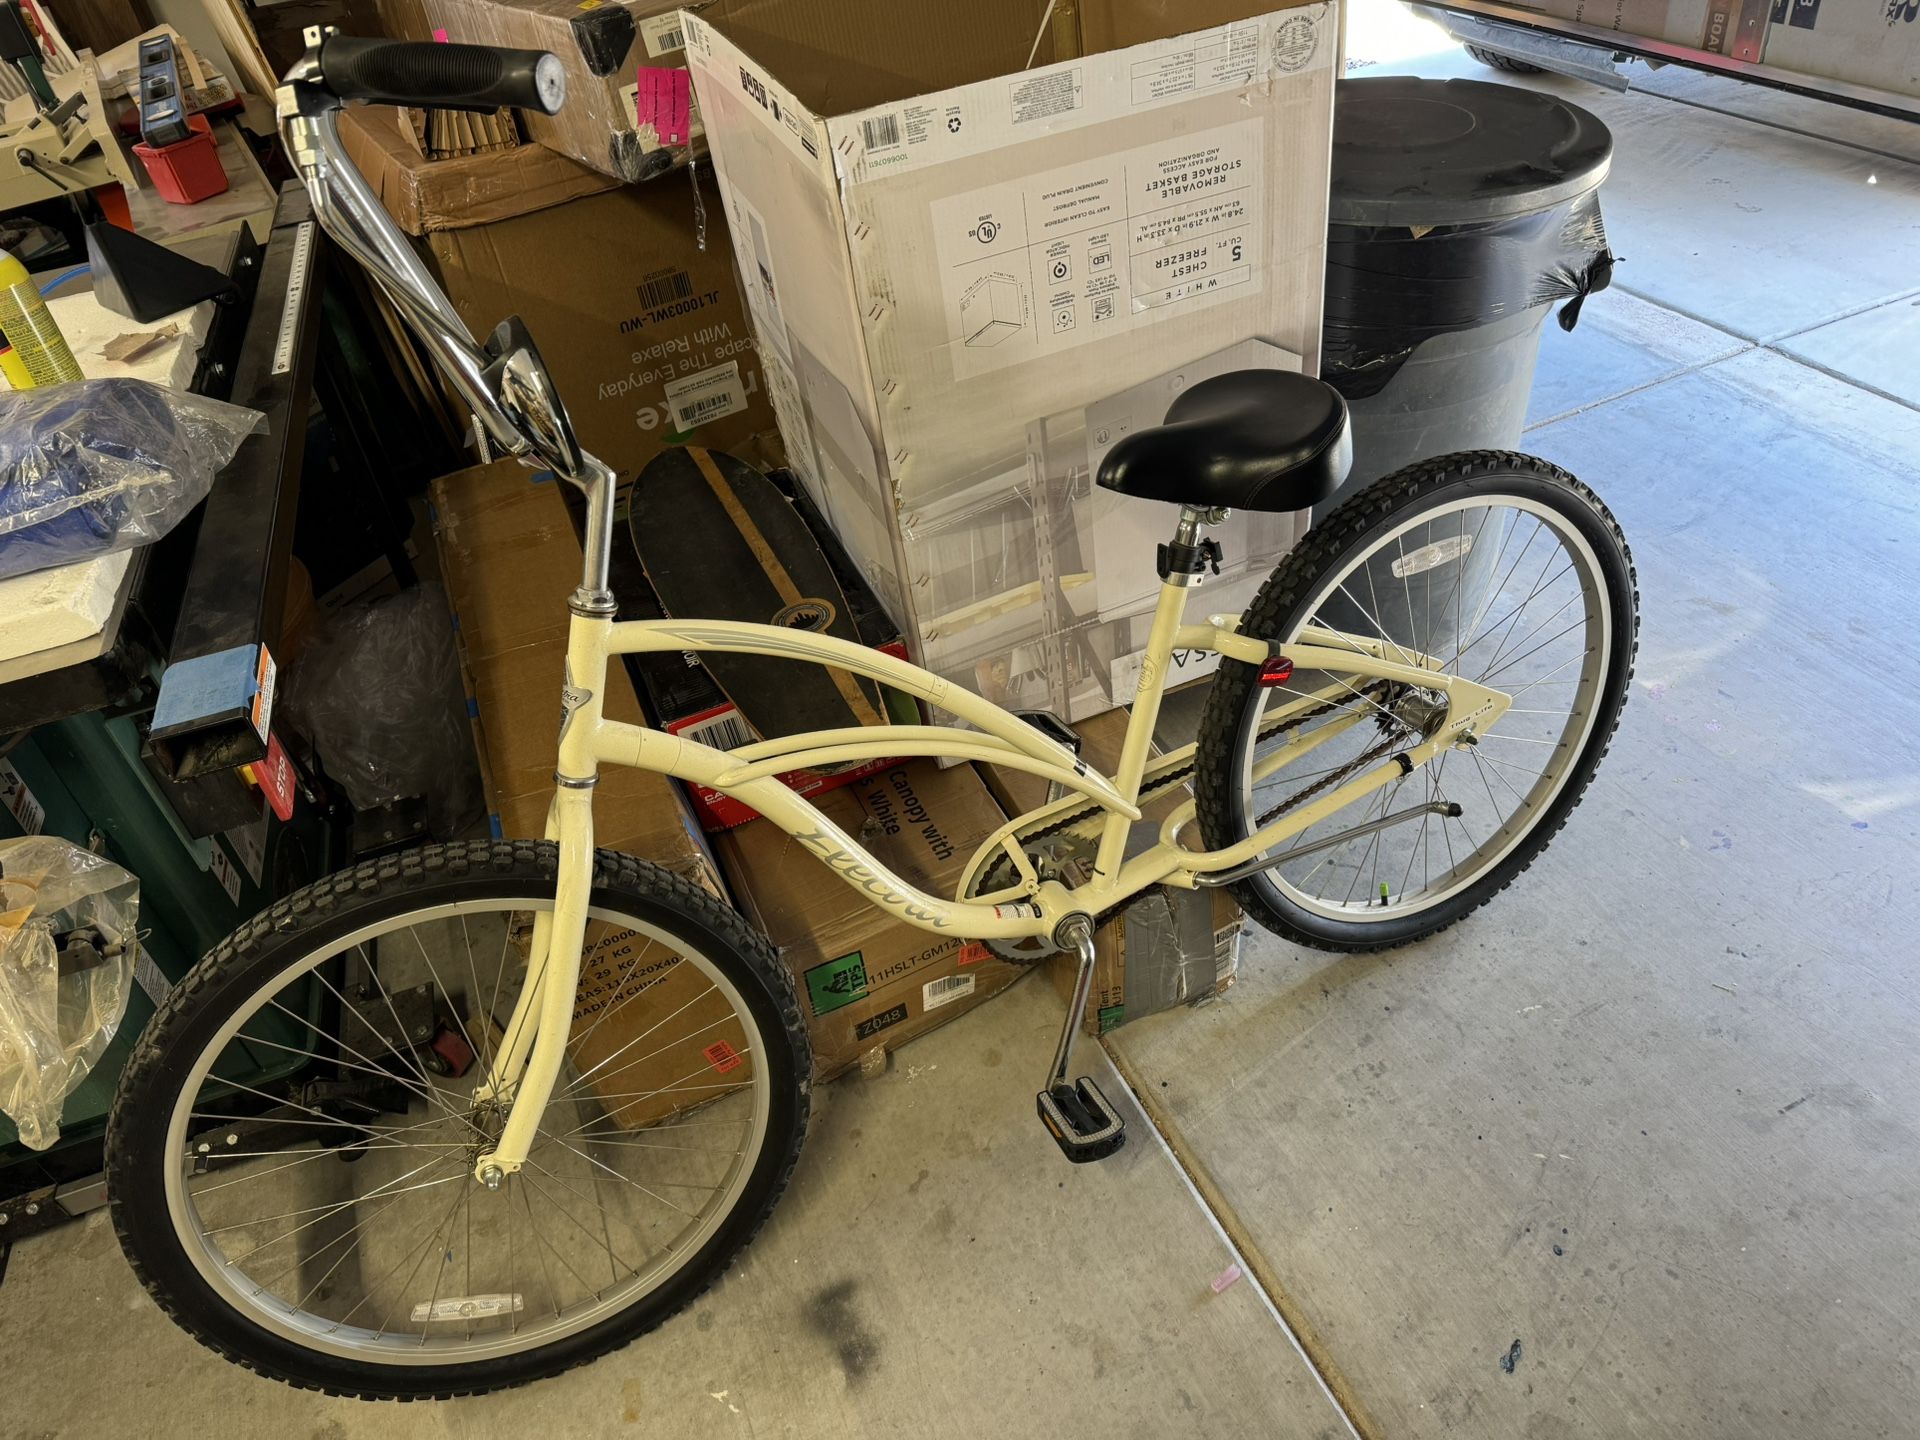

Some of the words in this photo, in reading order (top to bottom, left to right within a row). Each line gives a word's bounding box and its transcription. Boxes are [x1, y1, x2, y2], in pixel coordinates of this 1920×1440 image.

[1158, 151, 1205, 168] ORGANIZATION
[1162, 163, 1186, 174] ACCESS
[1188, 158, 1204, 167] EASY
[1192, 159, 1242, 179] STORAGE
[1145, 173, 1188, 192] BASKET
[1161, 175, 1226, 199] REMOVABLE
[1093, 254, 1110, 265] LED
[1155, 247, 1207, 269] FREEZER
[1232, 245, 1241, 261] 5
[1171, 261, 1207, 278] CHEST
[1164, 279, 1217, 300] WHITE
[620, 290, 719, 334] JL10003WL-WU
[694, 322, 732, 346] With
[631, 335, 691, 365] Relaxe
[714, 337, 753, 360] cape
[679, 352, 712, 372] The
[598, 363, 676, 400] Everyday
[1451, 717, 1470, 728] Thug
[1476, 705, 1492, 716] Life
[276, 756, 287, 797] STOP
[704, 791, 724, 802] CA
[868, 790, 900, 835] White
[890, 770, 930, 823] Canopy
[922, 824, 954, 861] with
[590, 956, 605, 968] 27
[612, 946, 632, 958] KG
[595, 969, 611, 980] 29
[618, 958, 636, 971] KG
[572, 1000, 607, 1020] MADE
[609, 993, 624, 1004] IN
[626, 976, 668, 996] CHINA
[1100, 990, 1109, 1008] Tent
[863, 1009, 901, 1036] Z048
